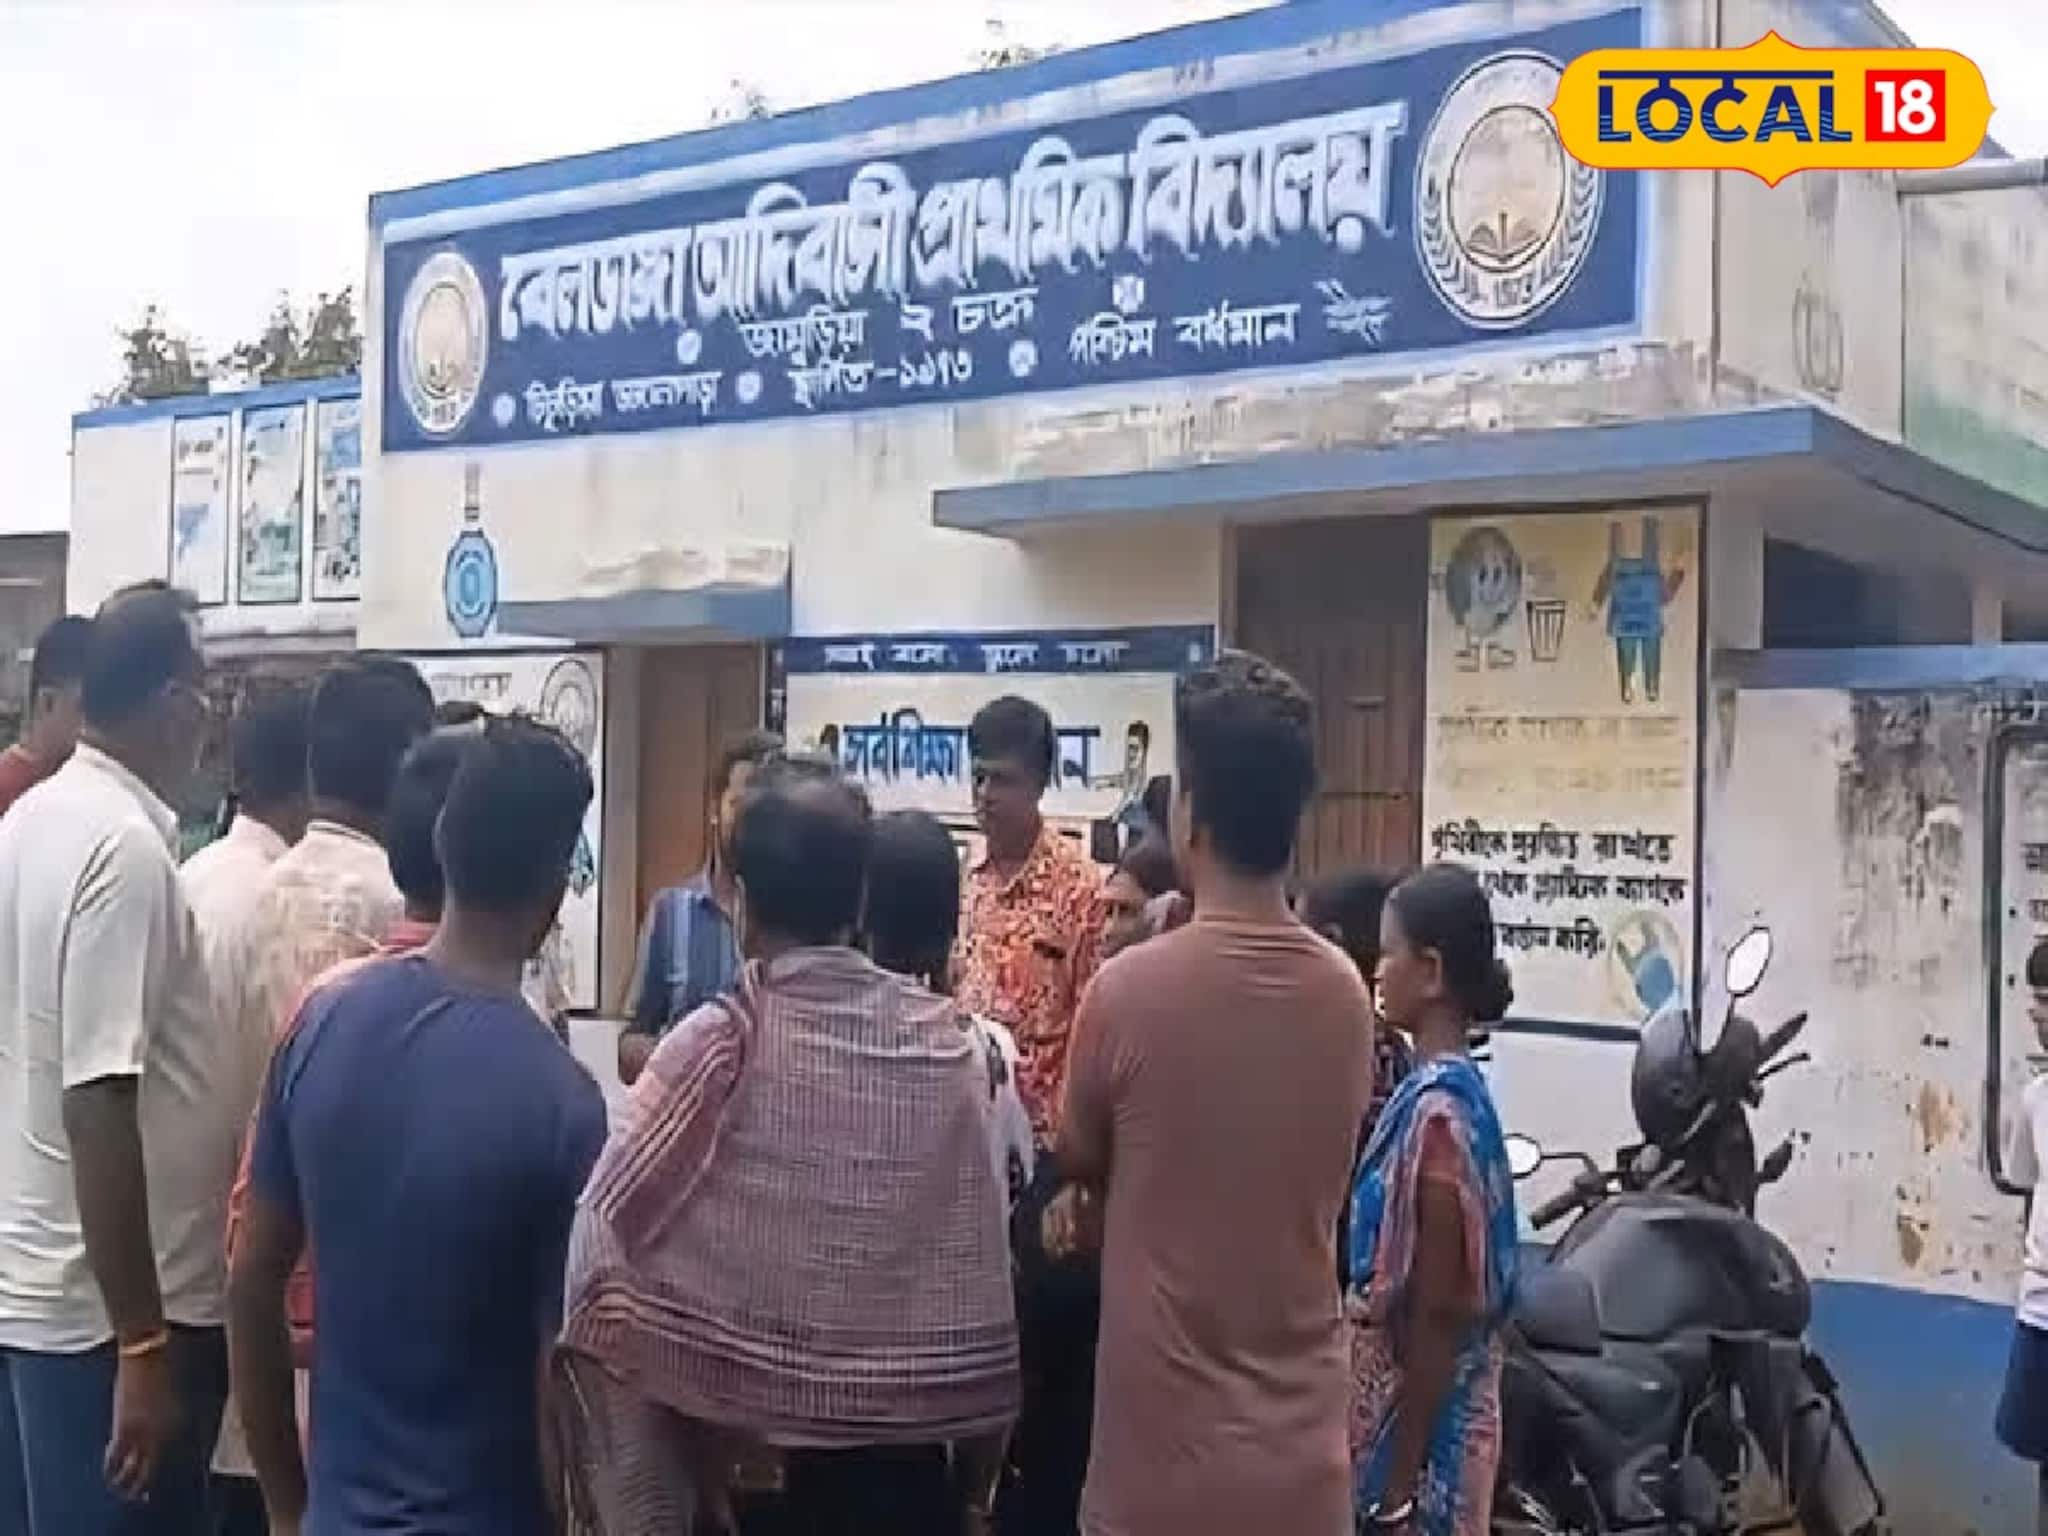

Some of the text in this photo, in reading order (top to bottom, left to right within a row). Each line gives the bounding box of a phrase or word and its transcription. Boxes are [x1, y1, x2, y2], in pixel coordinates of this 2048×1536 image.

[693, 162, 916, 320] আদিবাসী
[911, 136, 1130, 288] প্রাথমিক
[1127, 101, 1408, 261] বিদ্যালয়
[1173, 299, 1300, 351] বর্ধমান
